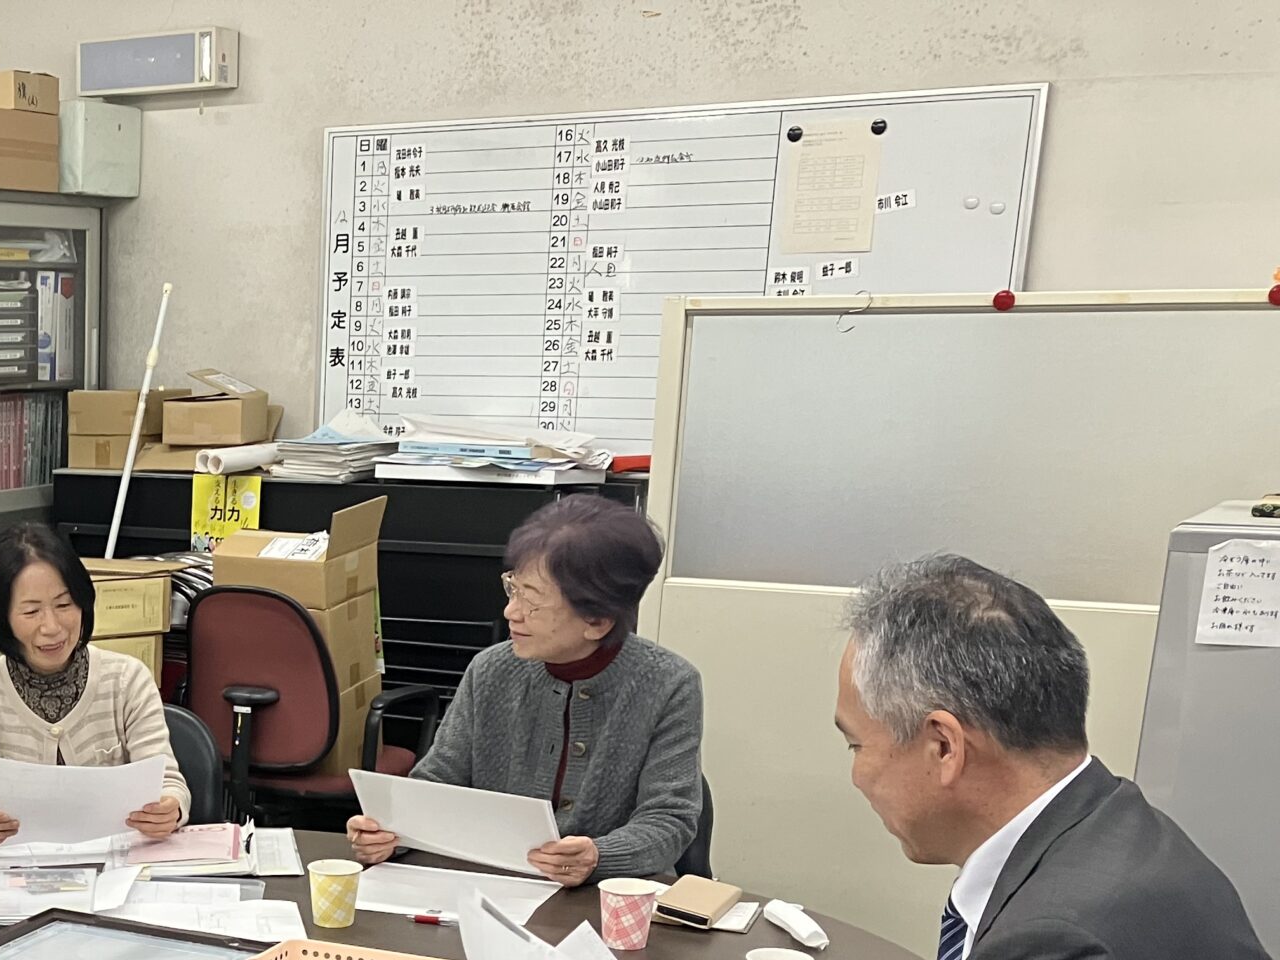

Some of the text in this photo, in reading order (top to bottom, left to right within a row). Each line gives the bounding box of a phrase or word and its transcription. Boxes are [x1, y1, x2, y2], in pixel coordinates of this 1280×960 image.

[558, 129, 573, 141] 16
[360, 139, 370, 152] 日
[556, 150, 572, 163] 17
[576, 149, 590, 164] 水
[361, 161, 366, 172] 1
[555, 172, 570, 184] 18
[574, 171, 586, 185] 木
[360, 181, 367, 192] 2
[554, 193, 569, 205] 19
[359, 201, 366, 212] 3
[373, 199, 386, 212] 水
[358, 221, 365, 232] 4
[552, 215, 568, 227] 20
[357, 241, 365, 252] 5
[551, 236, 566, 248] 21
[574, 236, 582, 246] 日
[356, 261, 364, 272] 6
[550, 257, 565, 269] 22
[356, 281, 364, 292] 7
[372, 282, 380, 291] 日
[548, 278, 564, 289] 23
[568, 277, 581, 293] 火
[355, 301, 362, 312] 8
[547, 299, 562, 310] 24
[566, 297, 583, 311] 水
[354, 321, 362, 332] 9
[546, 319, 561, 330] 25
[565, 317, 579, 331] 木
[350, 340, 364, 352] 10
[366, 339, 380, 354] 水
[545, 340, 560, 351] 26
[563, 337, 578, 355] 金
[350, 360, 363, 371] 11
[543, 361, 559, 372] 27
[560, 360, 577, 375] 土
[350, 379, 362, 390] 12
[542, 381, 557, 392] 28
[348, 398, 361, 409] 13
[541, 401, 556, 412] 29
[540, 422, 554, 430] 30
